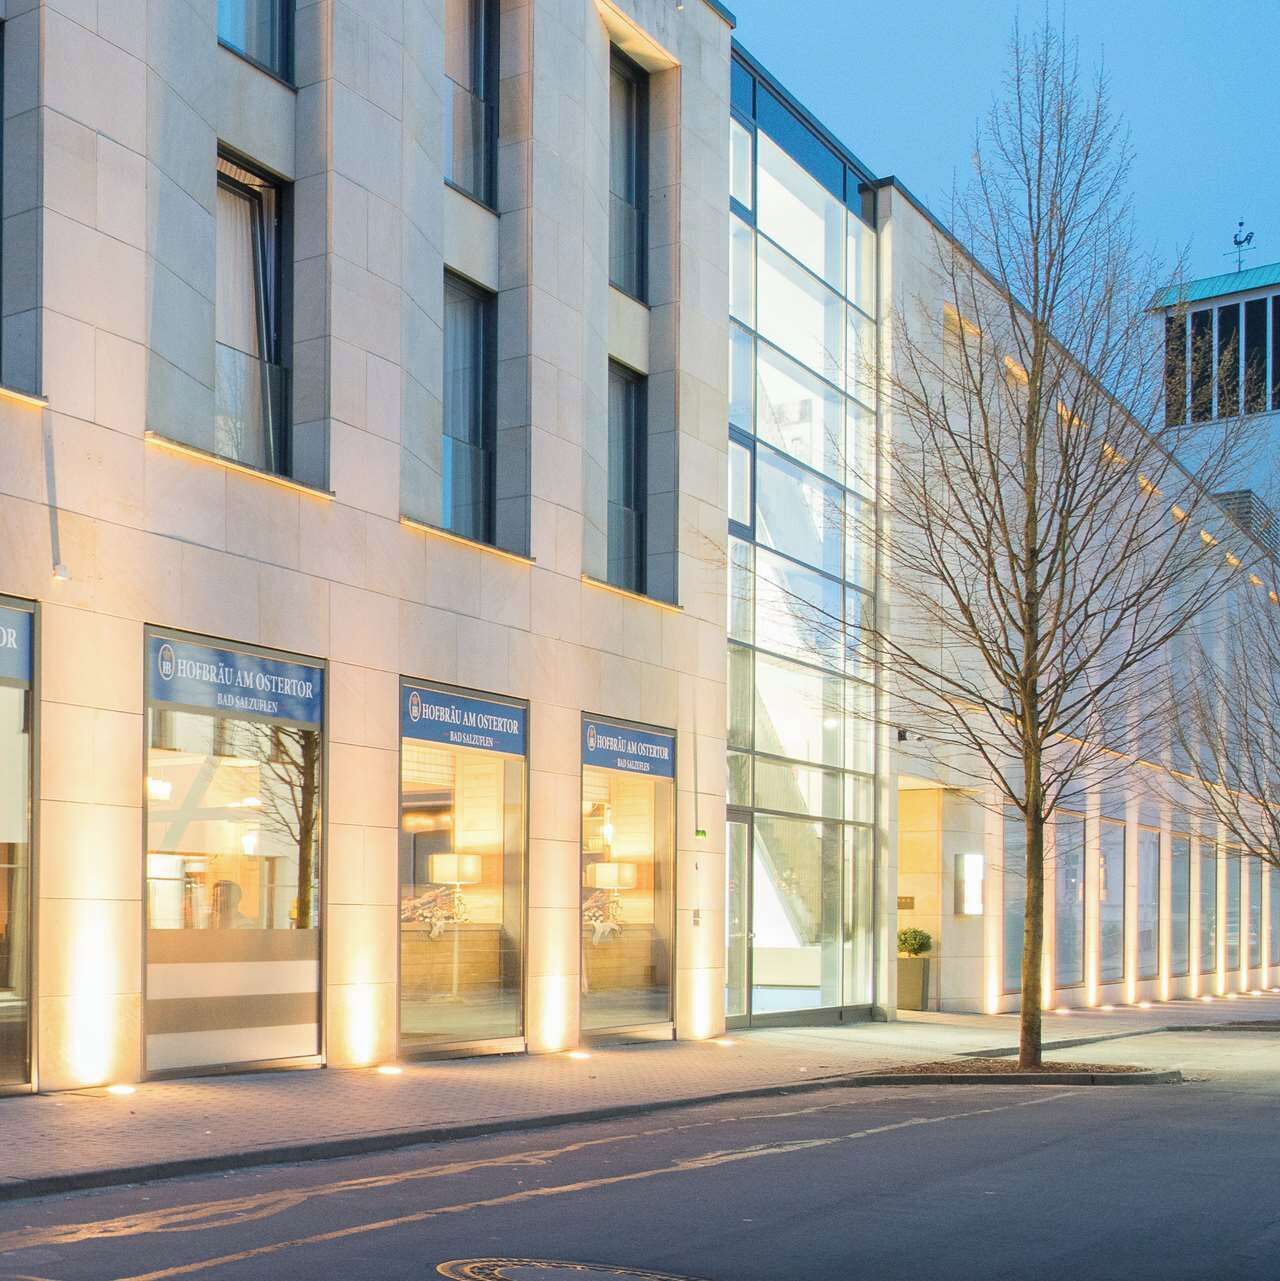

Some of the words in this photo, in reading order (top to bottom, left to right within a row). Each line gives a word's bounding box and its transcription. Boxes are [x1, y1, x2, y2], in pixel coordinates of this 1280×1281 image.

[176, 658, 233, 686] HOFBRÄU
[234, 669, 254, 689] AM
[255, 672, 313, 699] OSTERTOR
[217, 693, 234, 707] BAD
[235, 697, 278, 713] SALZUFLEN
[421, 703, 461, 725] HOFBRÄU
[462, 711, 476, 728] AM
[477, 713, 519, 735] OSTERTOR
[449, 730, 462, 743] BAD
[462, 732, 494, 747] SALZUFLEN
[596, 735, 626, 753] HOFBRÄU
[627, 740, 637, 754] AM
